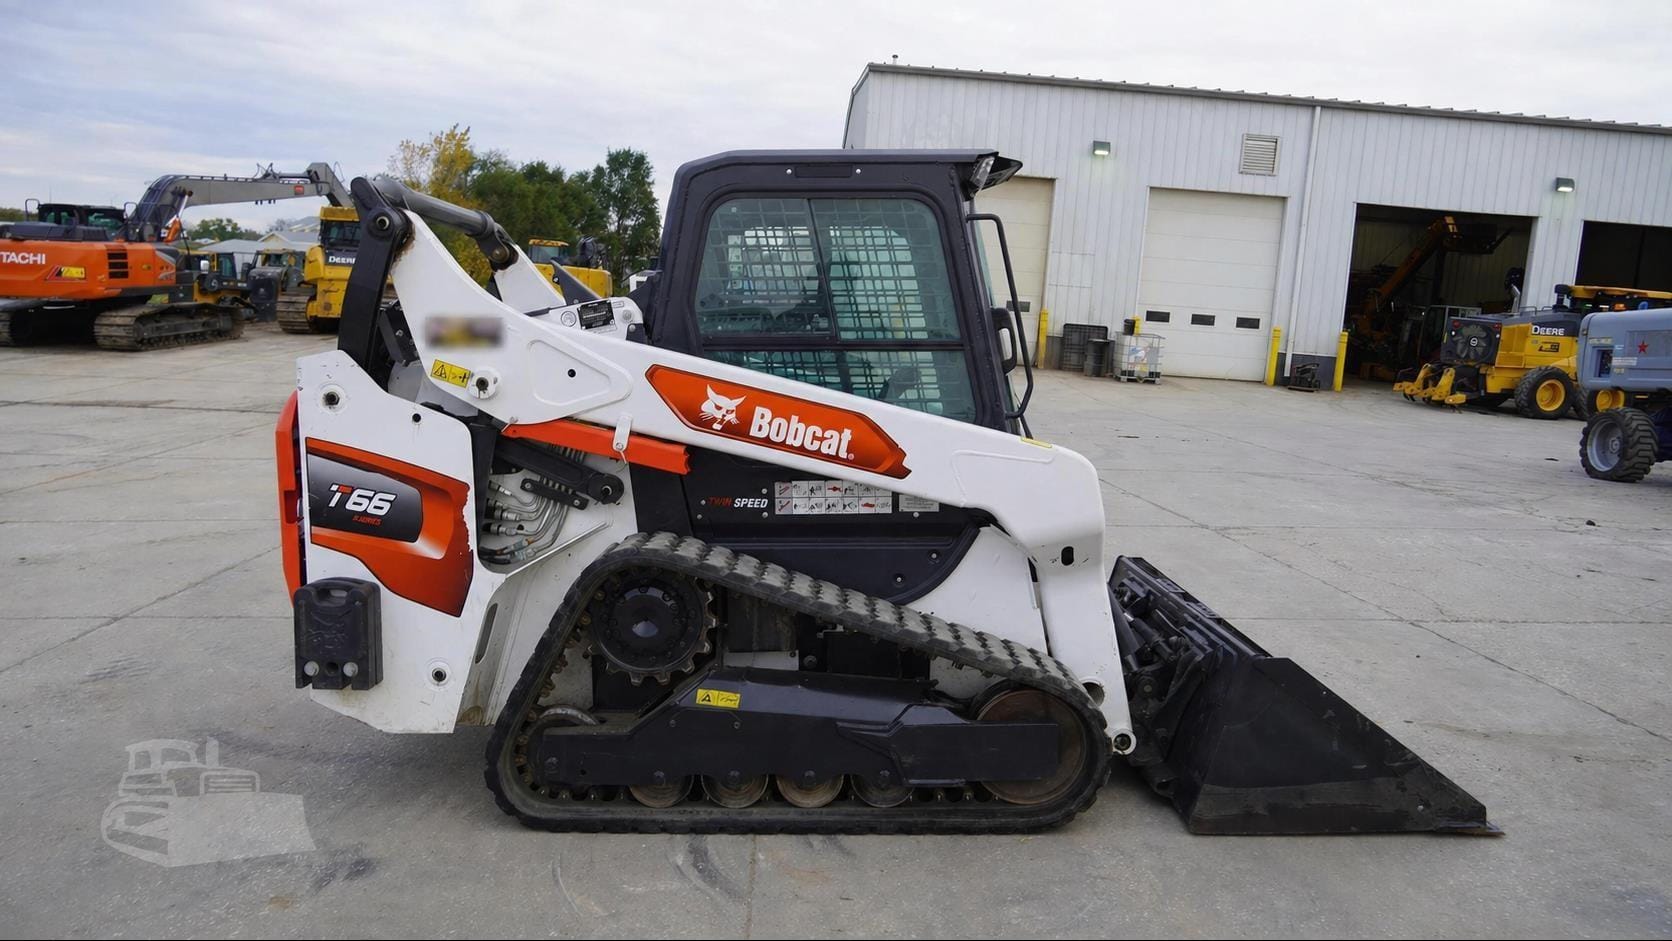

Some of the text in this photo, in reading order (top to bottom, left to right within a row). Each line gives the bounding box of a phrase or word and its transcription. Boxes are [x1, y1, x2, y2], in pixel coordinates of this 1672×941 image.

[1531, 325, 1565, 336] DEERE
[748, 405, 852, 459] Bobcat
[328, 484, 397, 516] T66
[733, 498, 769, 508] SPEED
